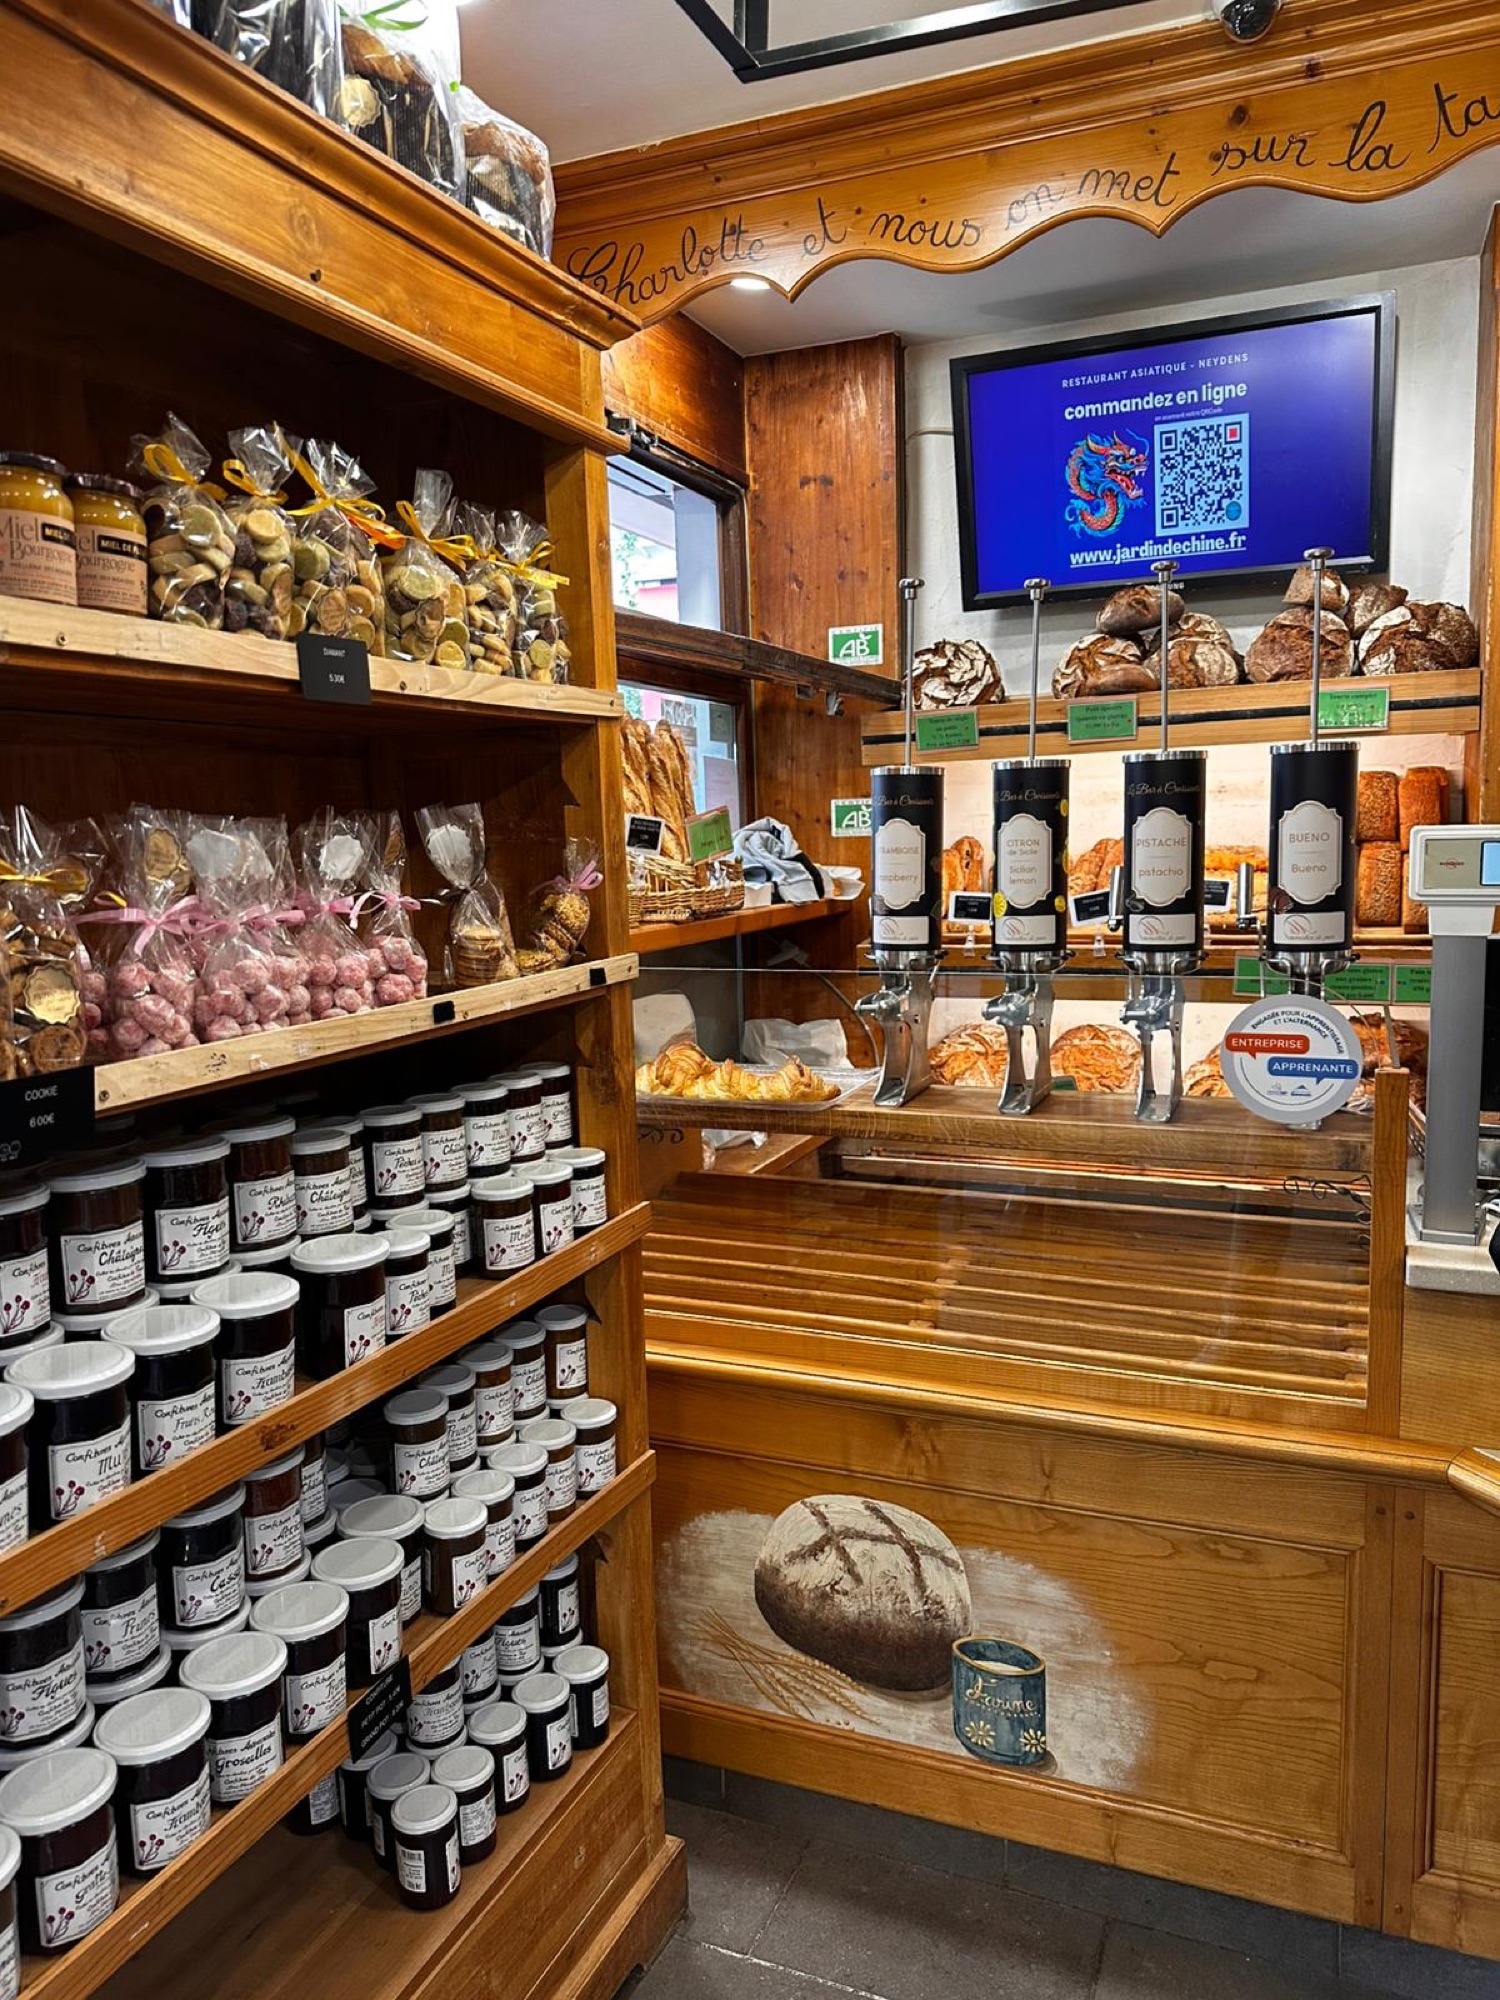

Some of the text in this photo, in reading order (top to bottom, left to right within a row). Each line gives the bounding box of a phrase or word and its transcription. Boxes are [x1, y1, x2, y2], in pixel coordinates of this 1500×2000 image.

[566, 214, 768, 304] Charlotte
[801, 197, 847, 259] et
[869, 211, 982, 248] nous
[1004, 184, 1063, 230] on
[1077, 152, 1182, 207] met
[1211, 133, 1316, 176] sur
[1328, 101, 1410, 172] la
[1062, 370, 1128, 388] RESTAURANT
[1130, 361, 1186, 379] ASIATIQUE
[1199, 353, 1249, 369] NEYDENS
[1064, 382, 1247, 420] commandez en ligne
[1070, 532, 1246, 565] www.jardindechine.fr
[839, 638, 870, 658] AB
[1006, 839, 1040, 847] CITRON
[1136, 837, 1187, 847] PISTACHE
[1289, 832, 1330, 843] BUENO
[1009, 865, 1038, 874] Sicilian
[1138, 865, 1183, 879] pistachio
[1291, 864, 1327, 873] Bueno
[1009, 876, 1036, 885] lemon
[1231, 1038, 1304, 1049] ENTREPRISE
[1272, 1061, 1354, 1074] APPRENANTE
[24, 1085, 58, 1101] COOKIE
[966, 1675, 1036, 1711] Farine
